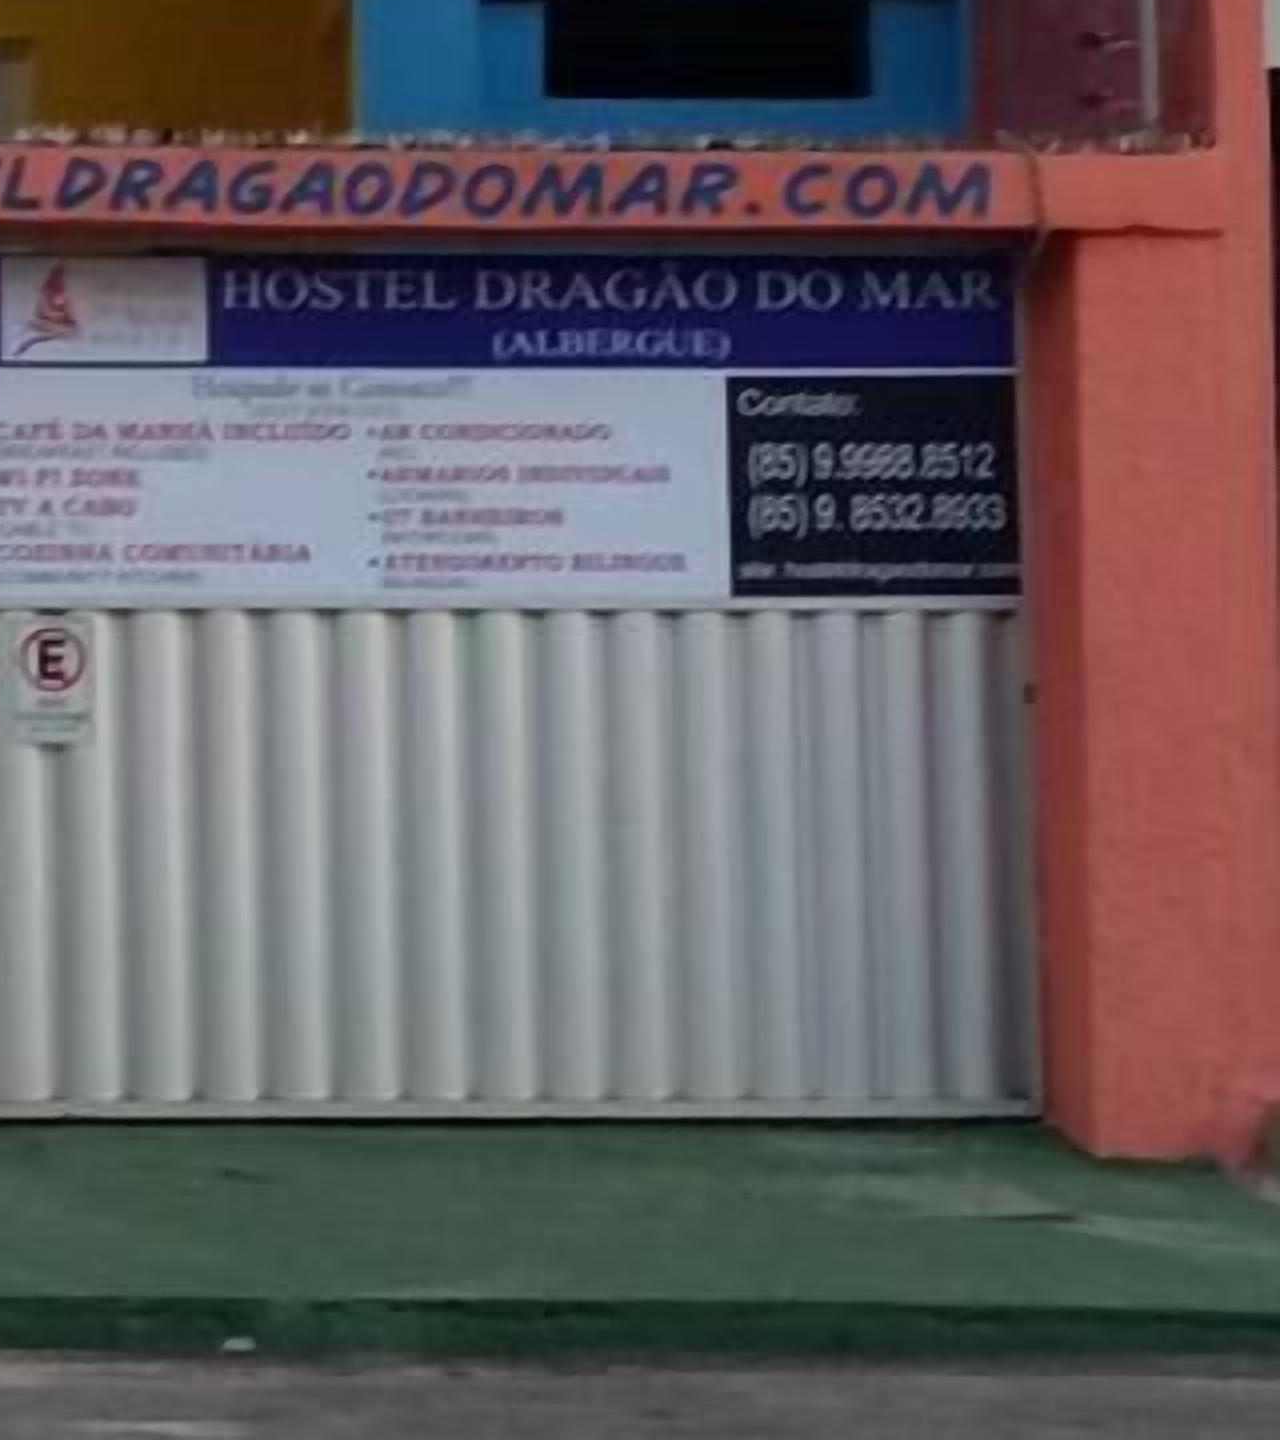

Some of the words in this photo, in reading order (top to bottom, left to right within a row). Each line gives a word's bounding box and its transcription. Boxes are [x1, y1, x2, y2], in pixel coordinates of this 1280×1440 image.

[222, 269, 456, 310] HOSTEL
[474, 261, 738, 311] DRAGÃO
[756, 269, 841, 311] DO
[860, 269, 997, 310] MAR
[493, 328, 732, 361] (ALBERGUE)
[38, 639, 66, 681] E
